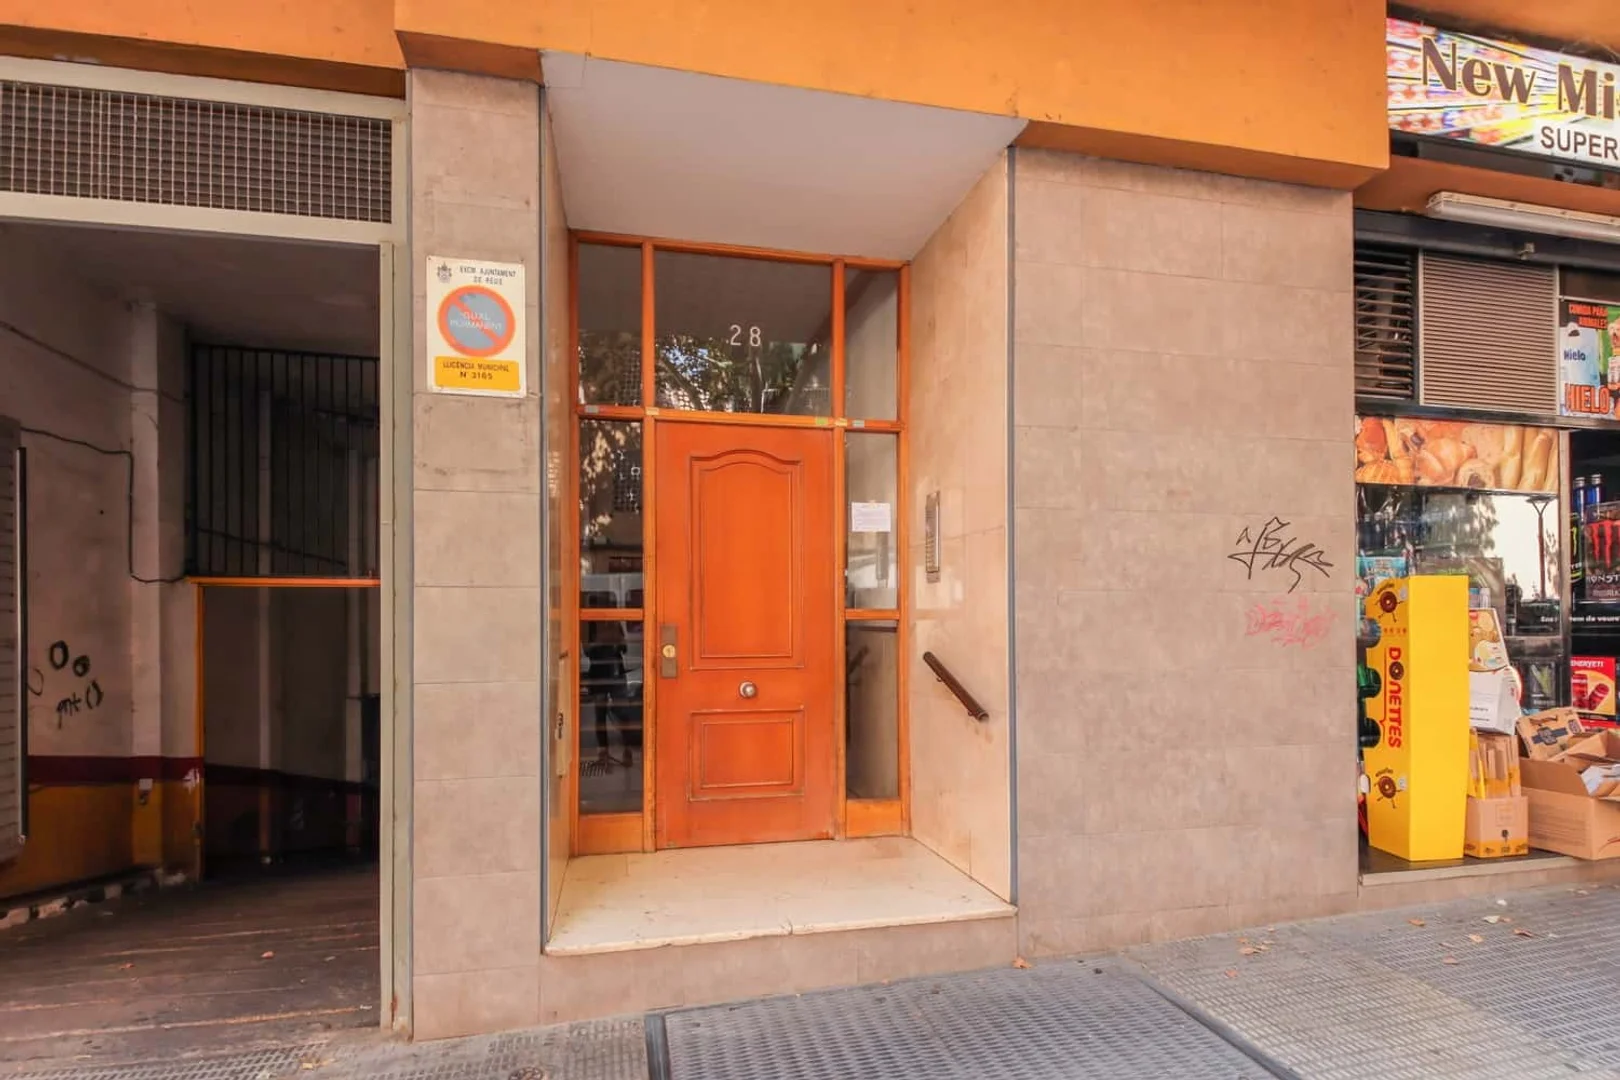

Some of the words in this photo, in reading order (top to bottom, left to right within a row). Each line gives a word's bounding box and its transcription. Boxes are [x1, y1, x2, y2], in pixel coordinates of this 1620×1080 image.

[1422, 37, 1536, 105] New
[1557, 63, 1620, 120] Mi
[730, 324, 761, 347] 28
[1564, 349, 1587, 361] Hielo
[1565, 383, 1611, 415] HIELO
